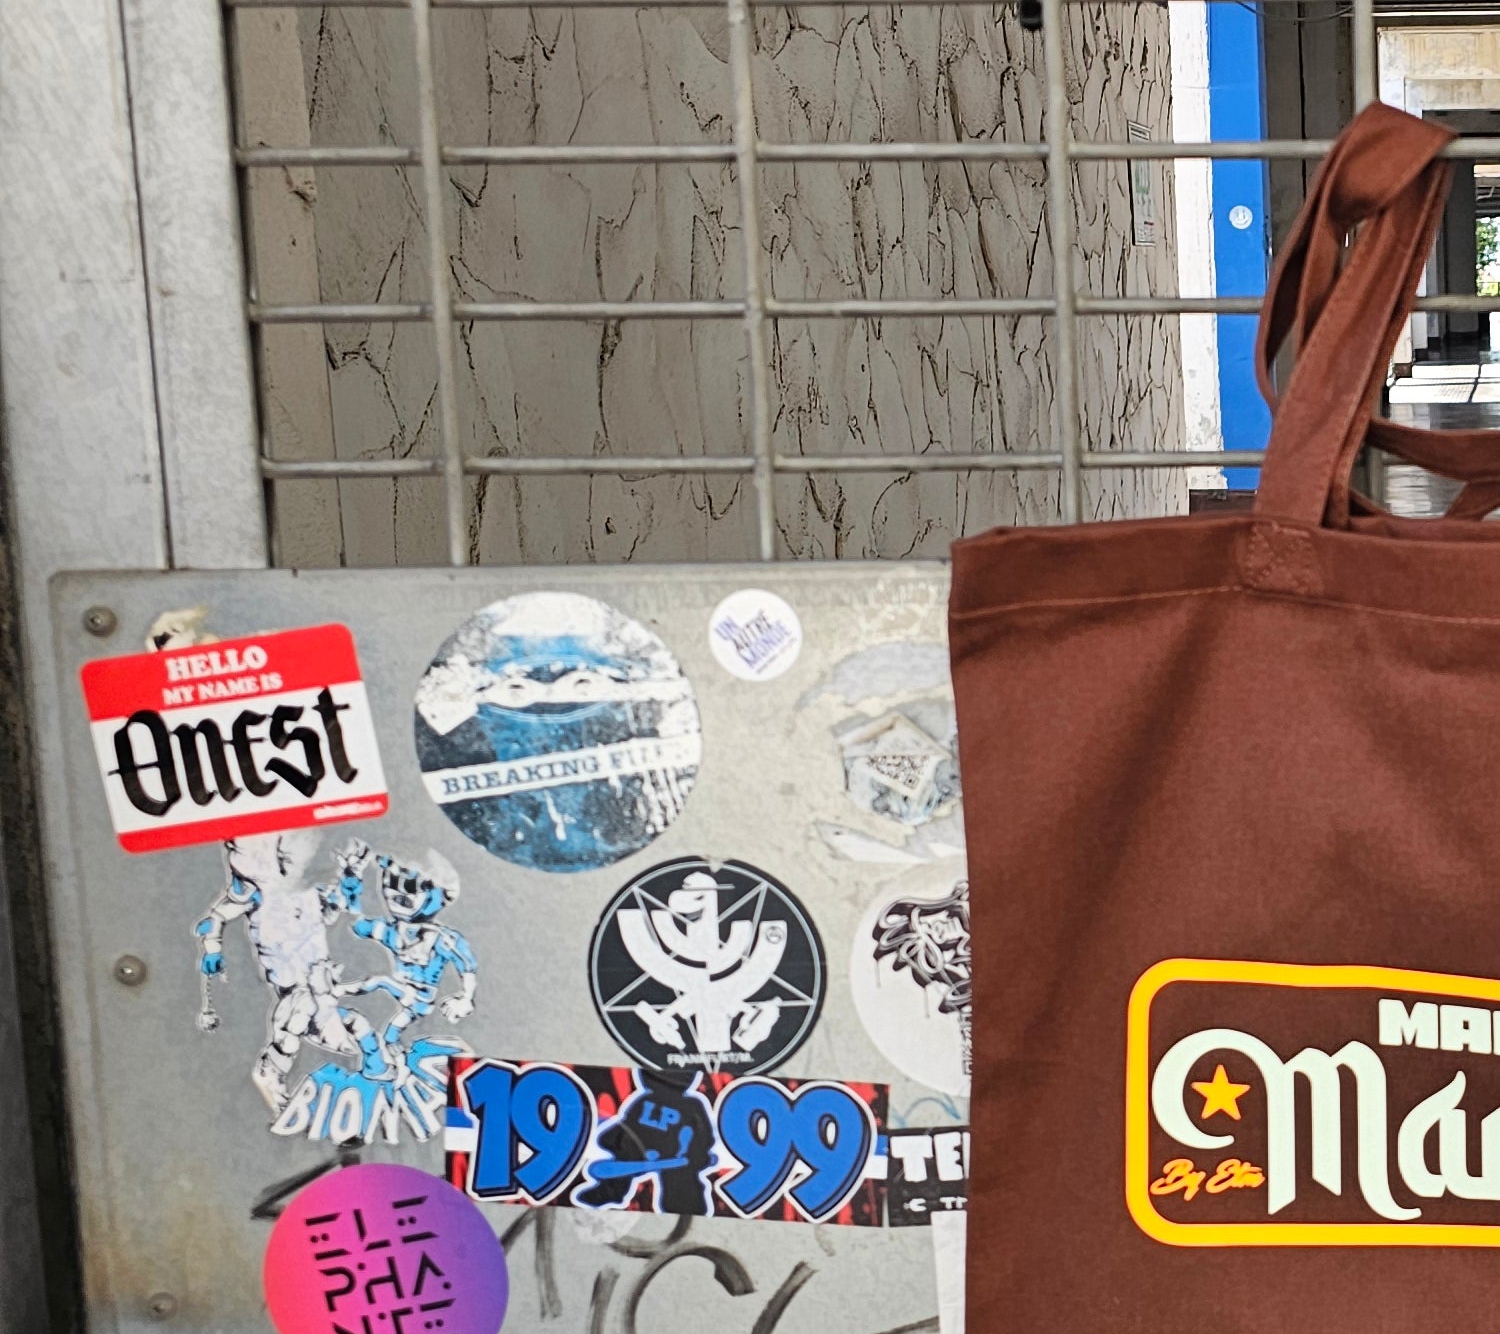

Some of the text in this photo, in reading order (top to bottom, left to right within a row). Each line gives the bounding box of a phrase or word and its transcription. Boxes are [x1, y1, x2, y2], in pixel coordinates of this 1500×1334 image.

[165, 645, 268, 682] HELLO
[162, 671, 283, 706] MY NAME IS
[441, 755, 598, 796] BREAKING
[639, 1101, 680, 1131] LP
